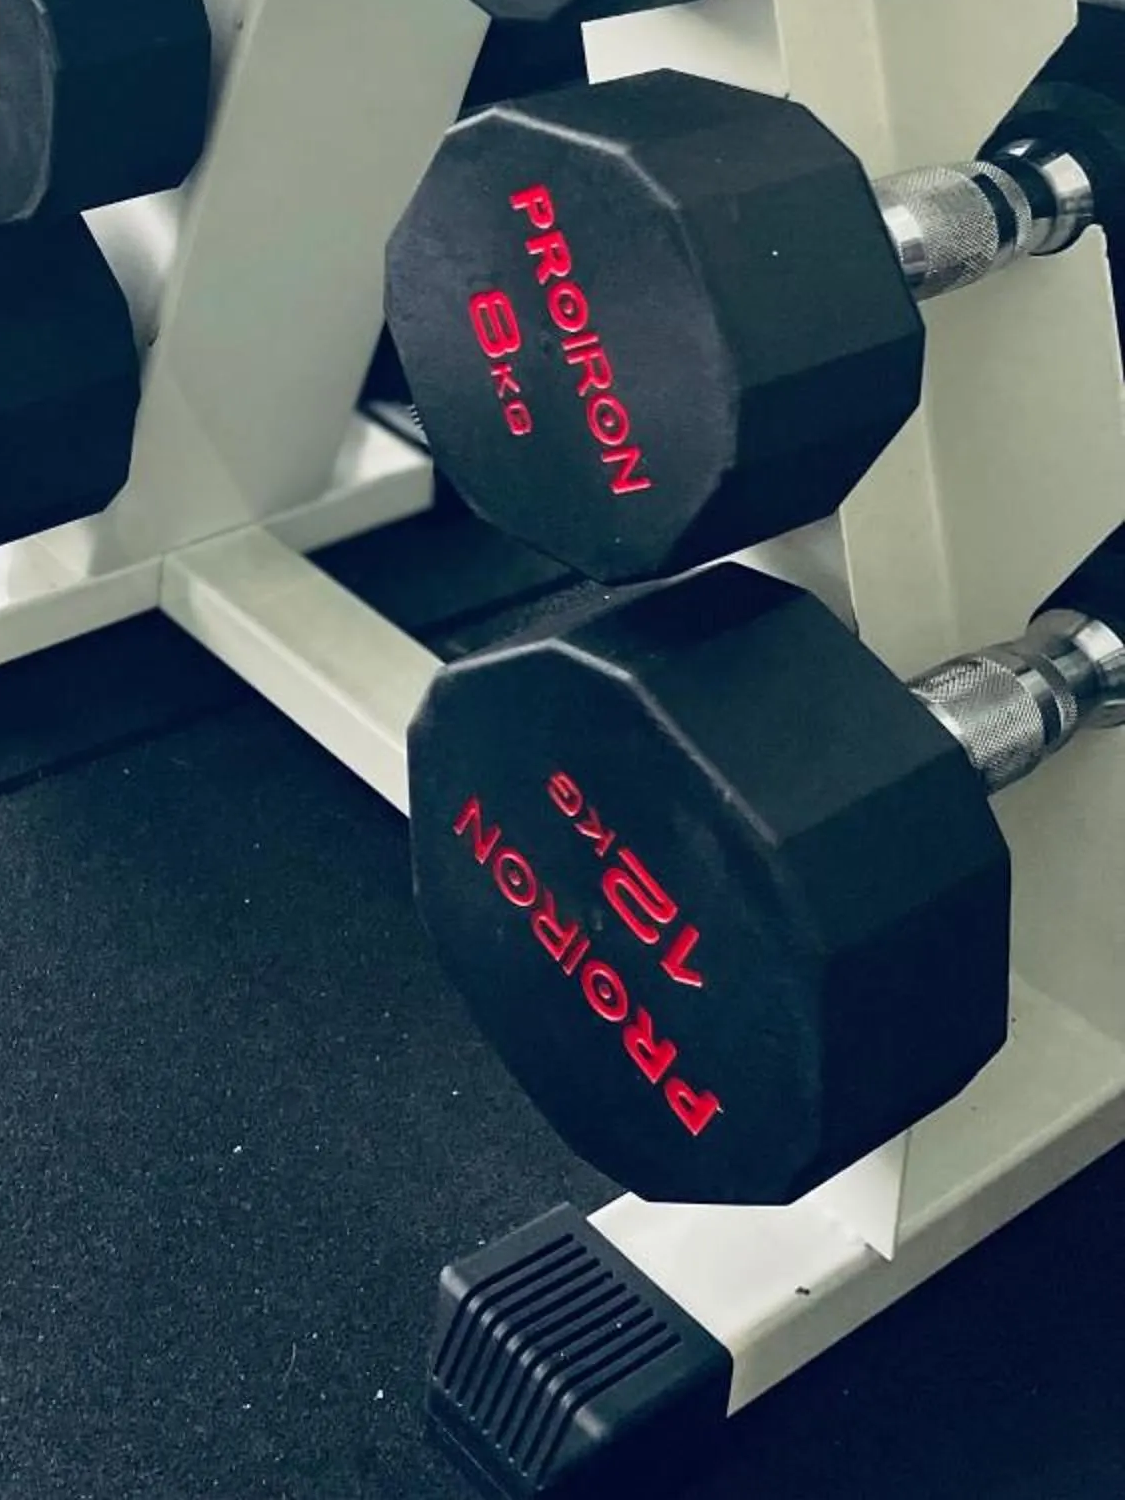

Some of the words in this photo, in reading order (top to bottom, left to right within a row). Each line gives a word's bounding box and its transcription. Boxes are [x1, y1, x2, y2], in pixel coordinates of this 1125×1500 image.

[468, 288, 532, 436] 8KG
[509, 184, 651, 494] PROIRON
[452, 795, 724, 1136] PROIRON
[547, 771, 704, 988] 12KG
